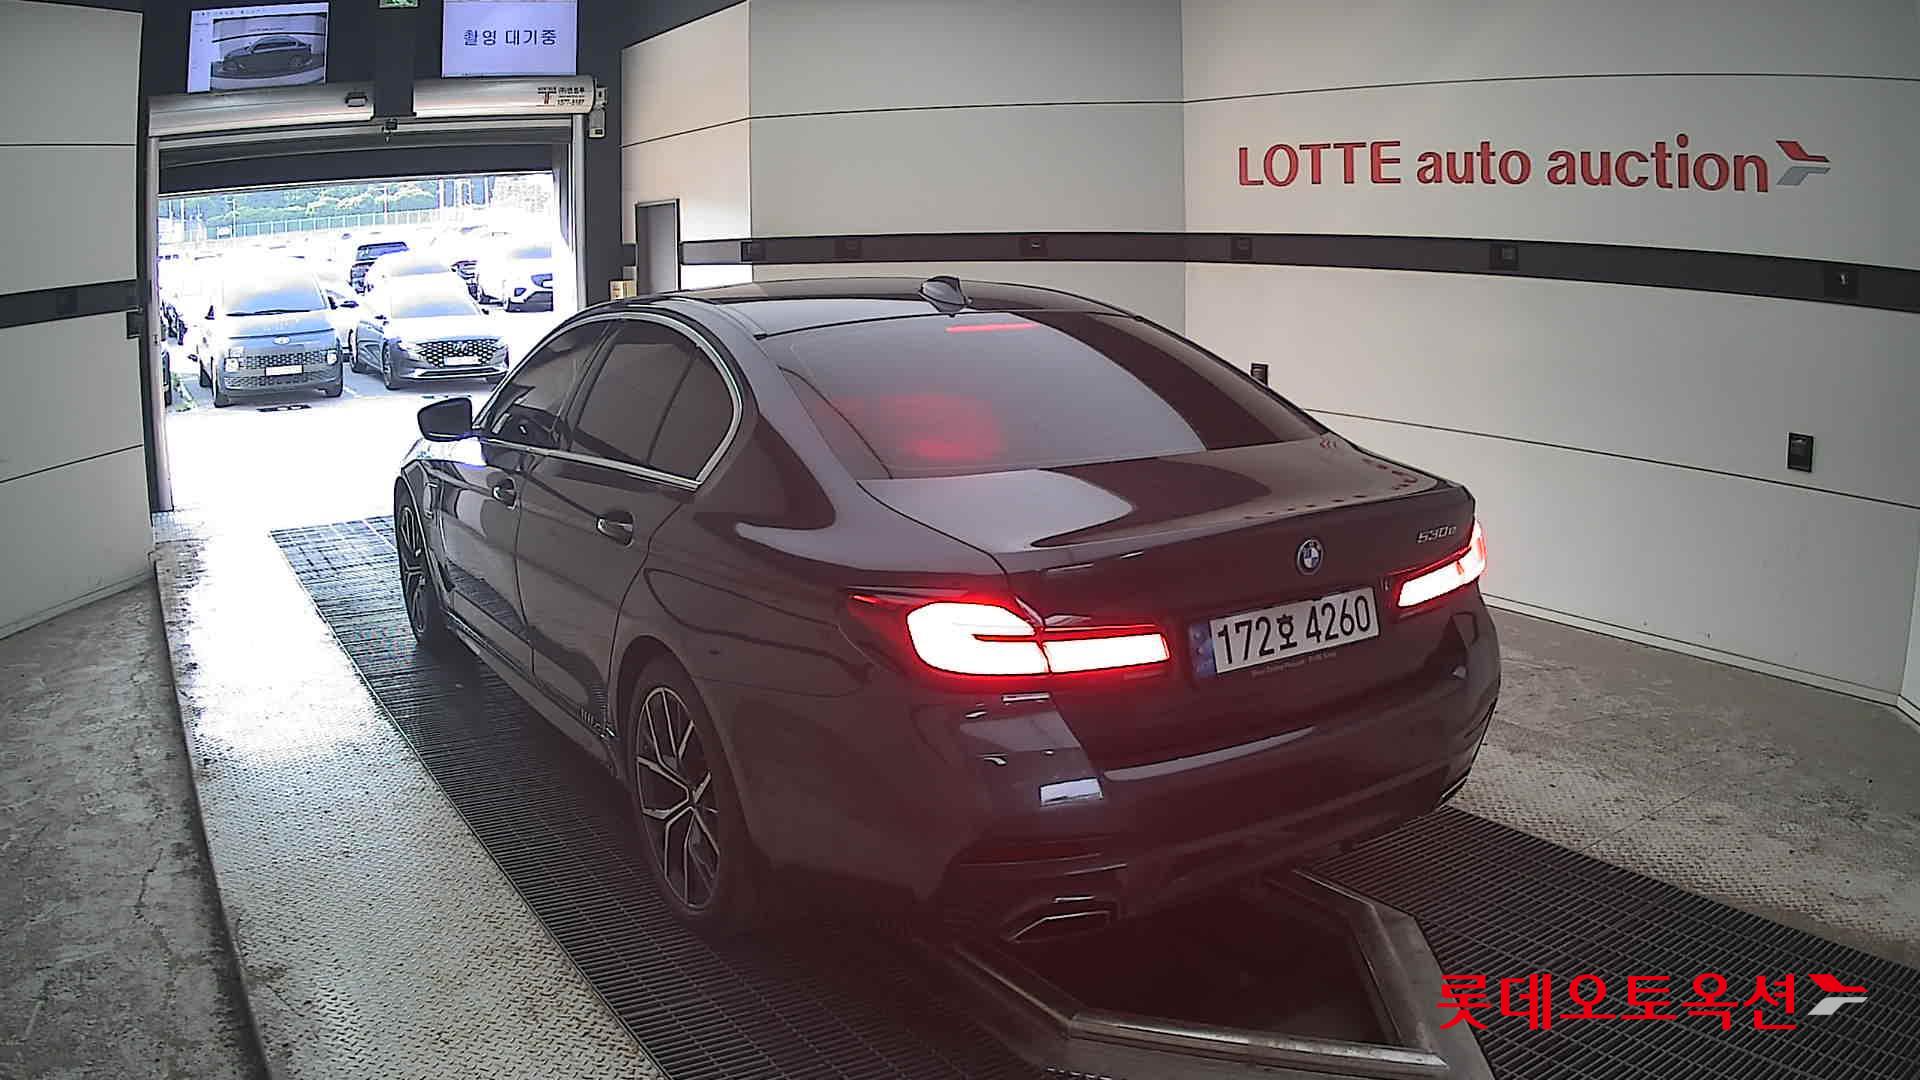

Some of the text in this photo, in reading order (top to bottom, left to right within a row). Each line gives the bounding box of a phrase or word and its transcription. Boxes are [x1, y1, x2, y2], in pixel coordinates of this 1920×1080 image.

[464, 29, 557, 46] 촬영 대기중
[1238, 133, 1768, 193] LOTTE auto auction
[1417, 526, 1457, 544] 530e
[1217, 613, 1298, 665] 172호
[1306, 595, 1371, 643] 4260
